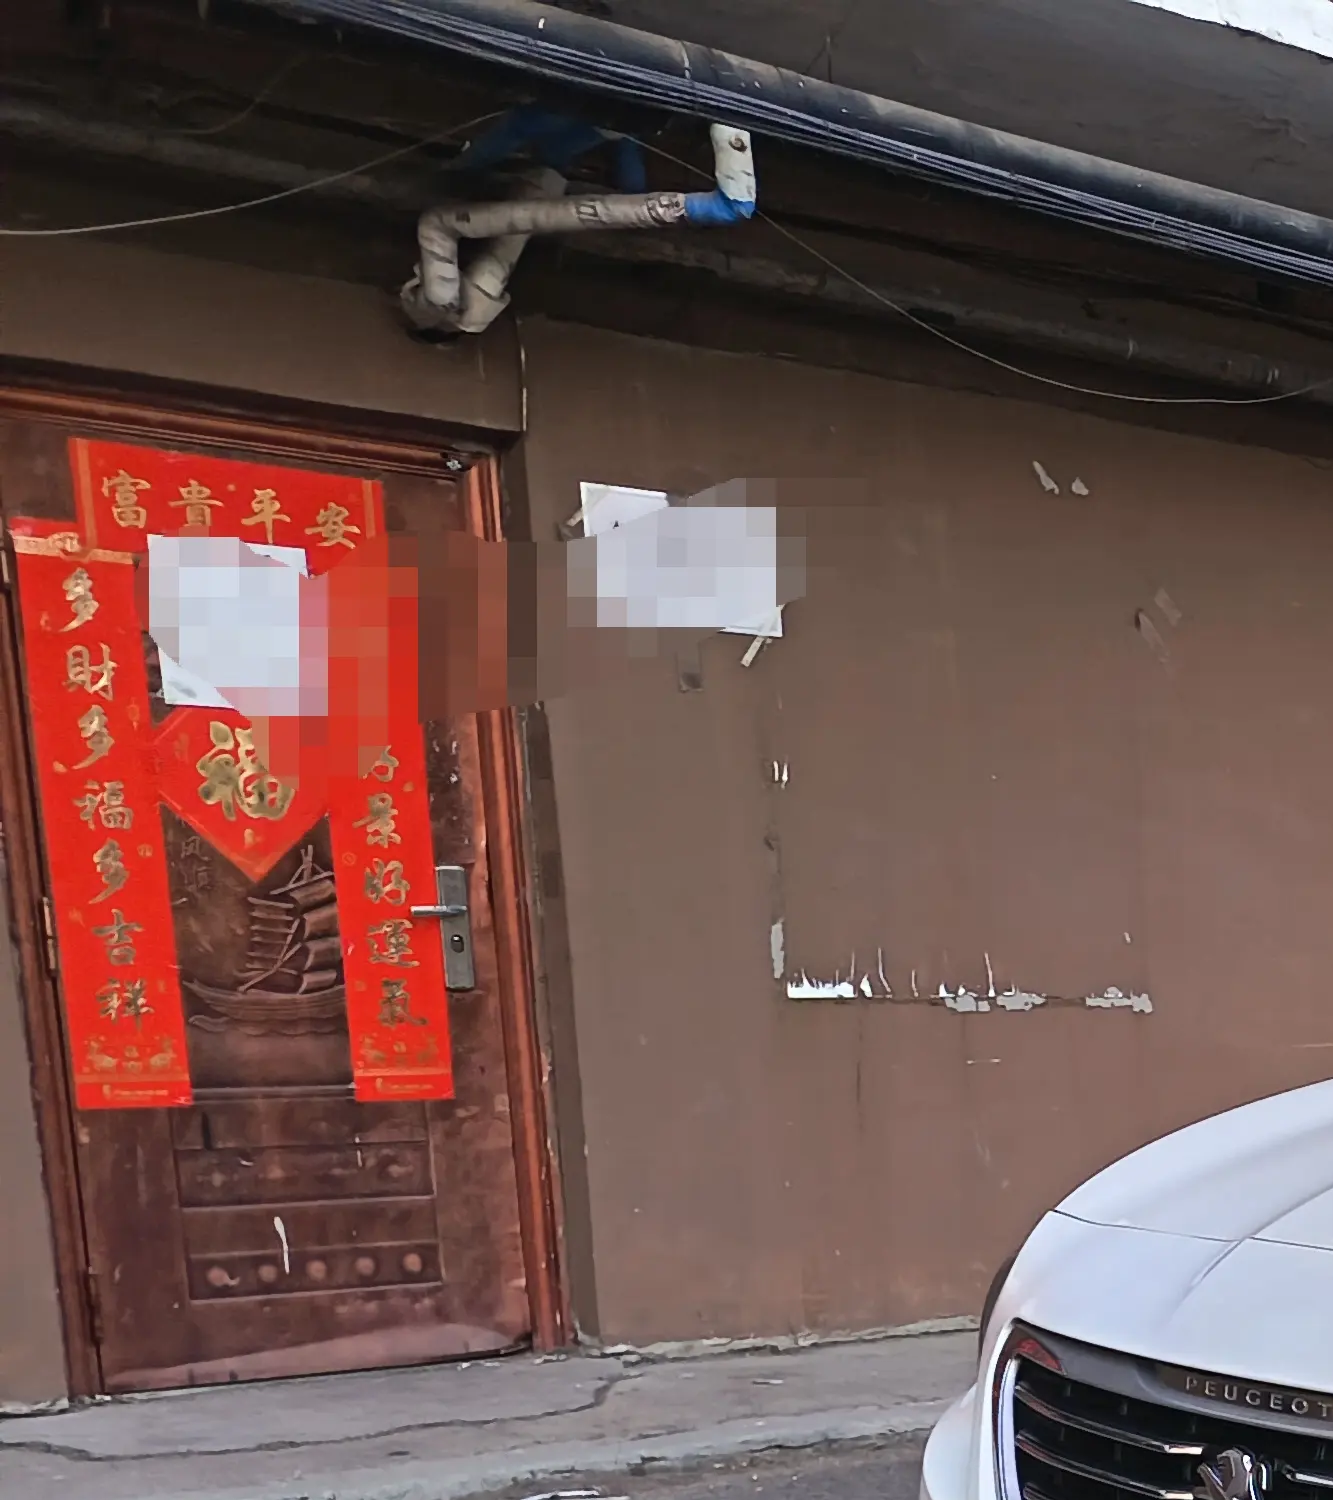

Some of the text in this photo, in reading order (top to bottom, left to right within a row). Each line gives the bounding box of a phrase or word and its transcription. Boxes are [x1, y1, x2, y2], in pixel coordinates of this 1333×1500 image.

[102, 469, 362, 550] 富貴平安
[1185, 1376, 1333, 1418] PEUGEOT
